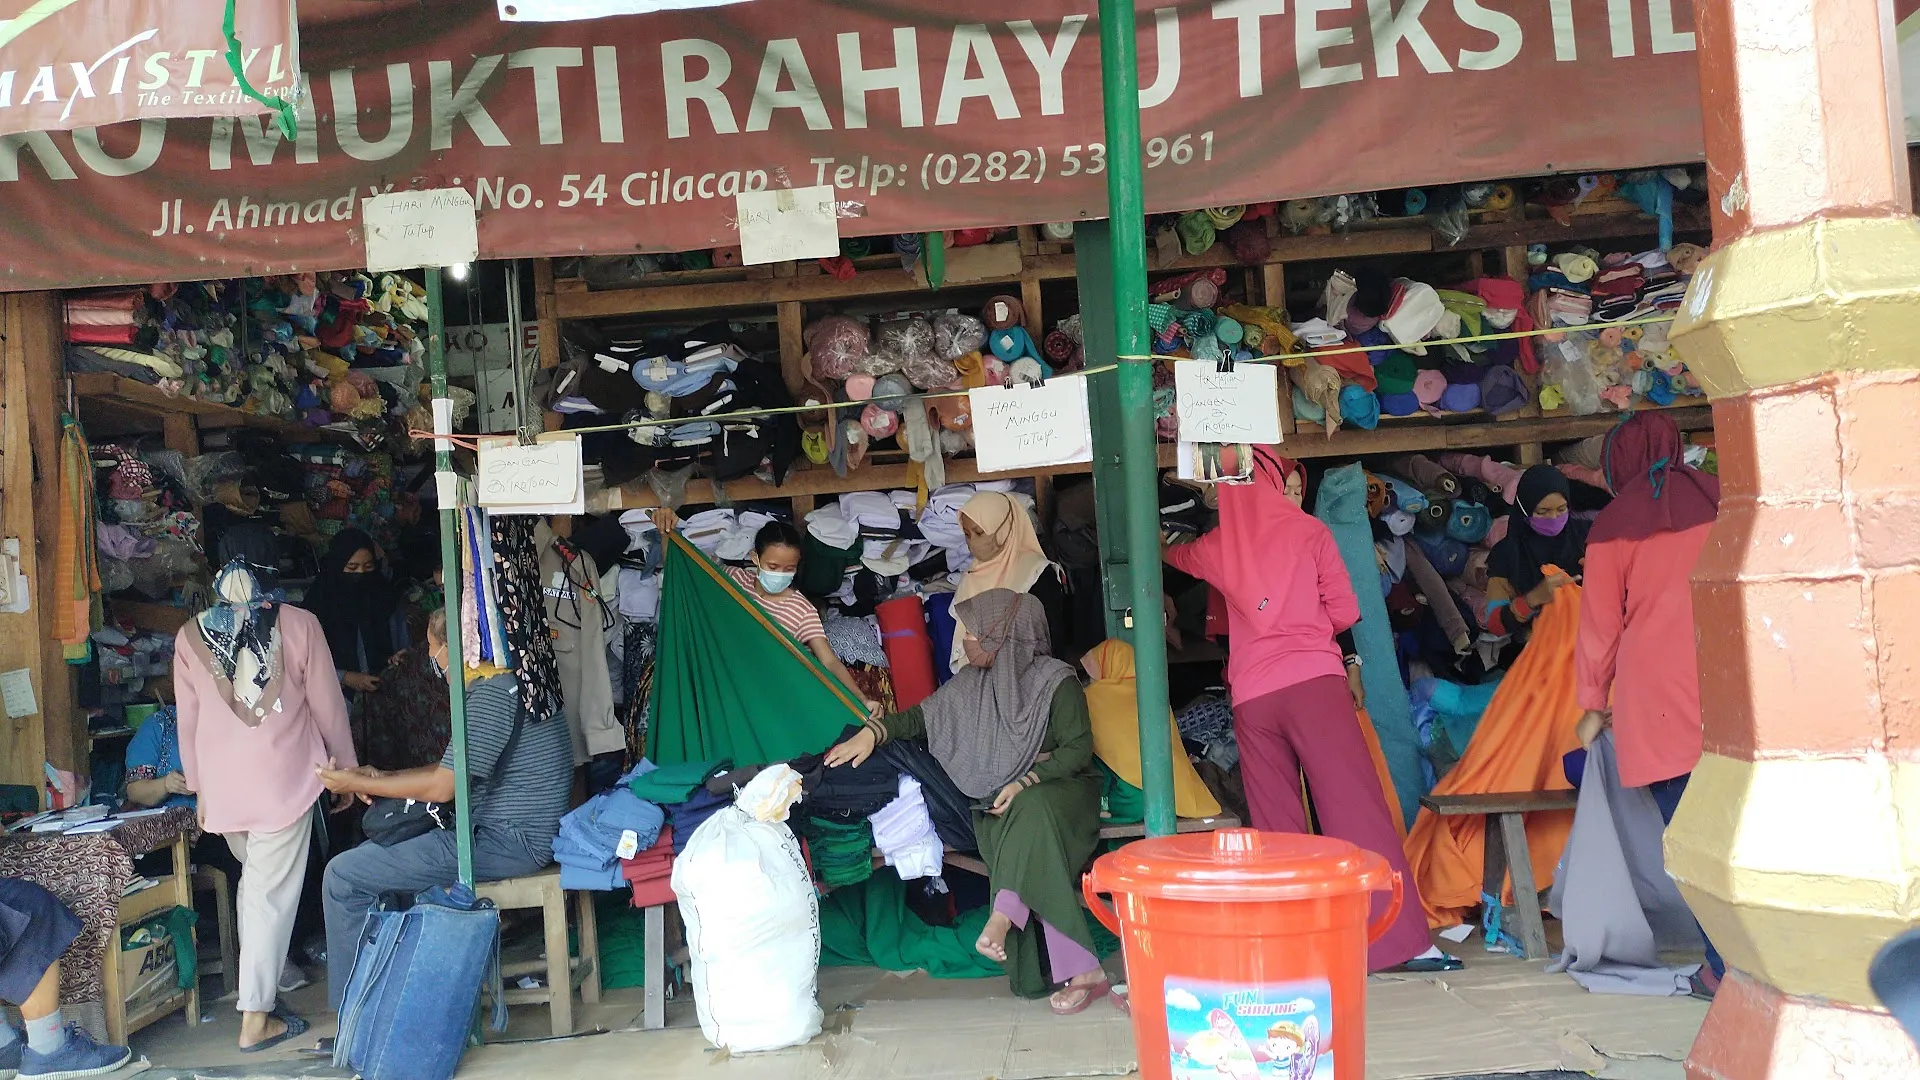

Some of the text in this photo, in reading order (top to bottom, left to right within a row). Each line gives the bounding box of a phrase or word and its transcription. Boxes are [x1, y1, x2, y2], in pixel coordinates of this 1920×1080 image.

[138, 84, 296, 106] The Textile Exp
[209, 45, 624, 170] MUKTI
[661, 8, 1181, 139] RAHAYU
[152, 198, 194, 237] Jl.
[206, 187, 356, 232] Ahmad
[477, 176, 544, 210] No.
[558, 174, 608, 207] 54
[621, 168, 768, 206] Cilacap
[811, 155, 906, 196] Telp:
[920, 146, 1047, 190] (0282)
[1146, 130, 1215, 169] 961
[1223, 986, 1258, 1010] FUN
